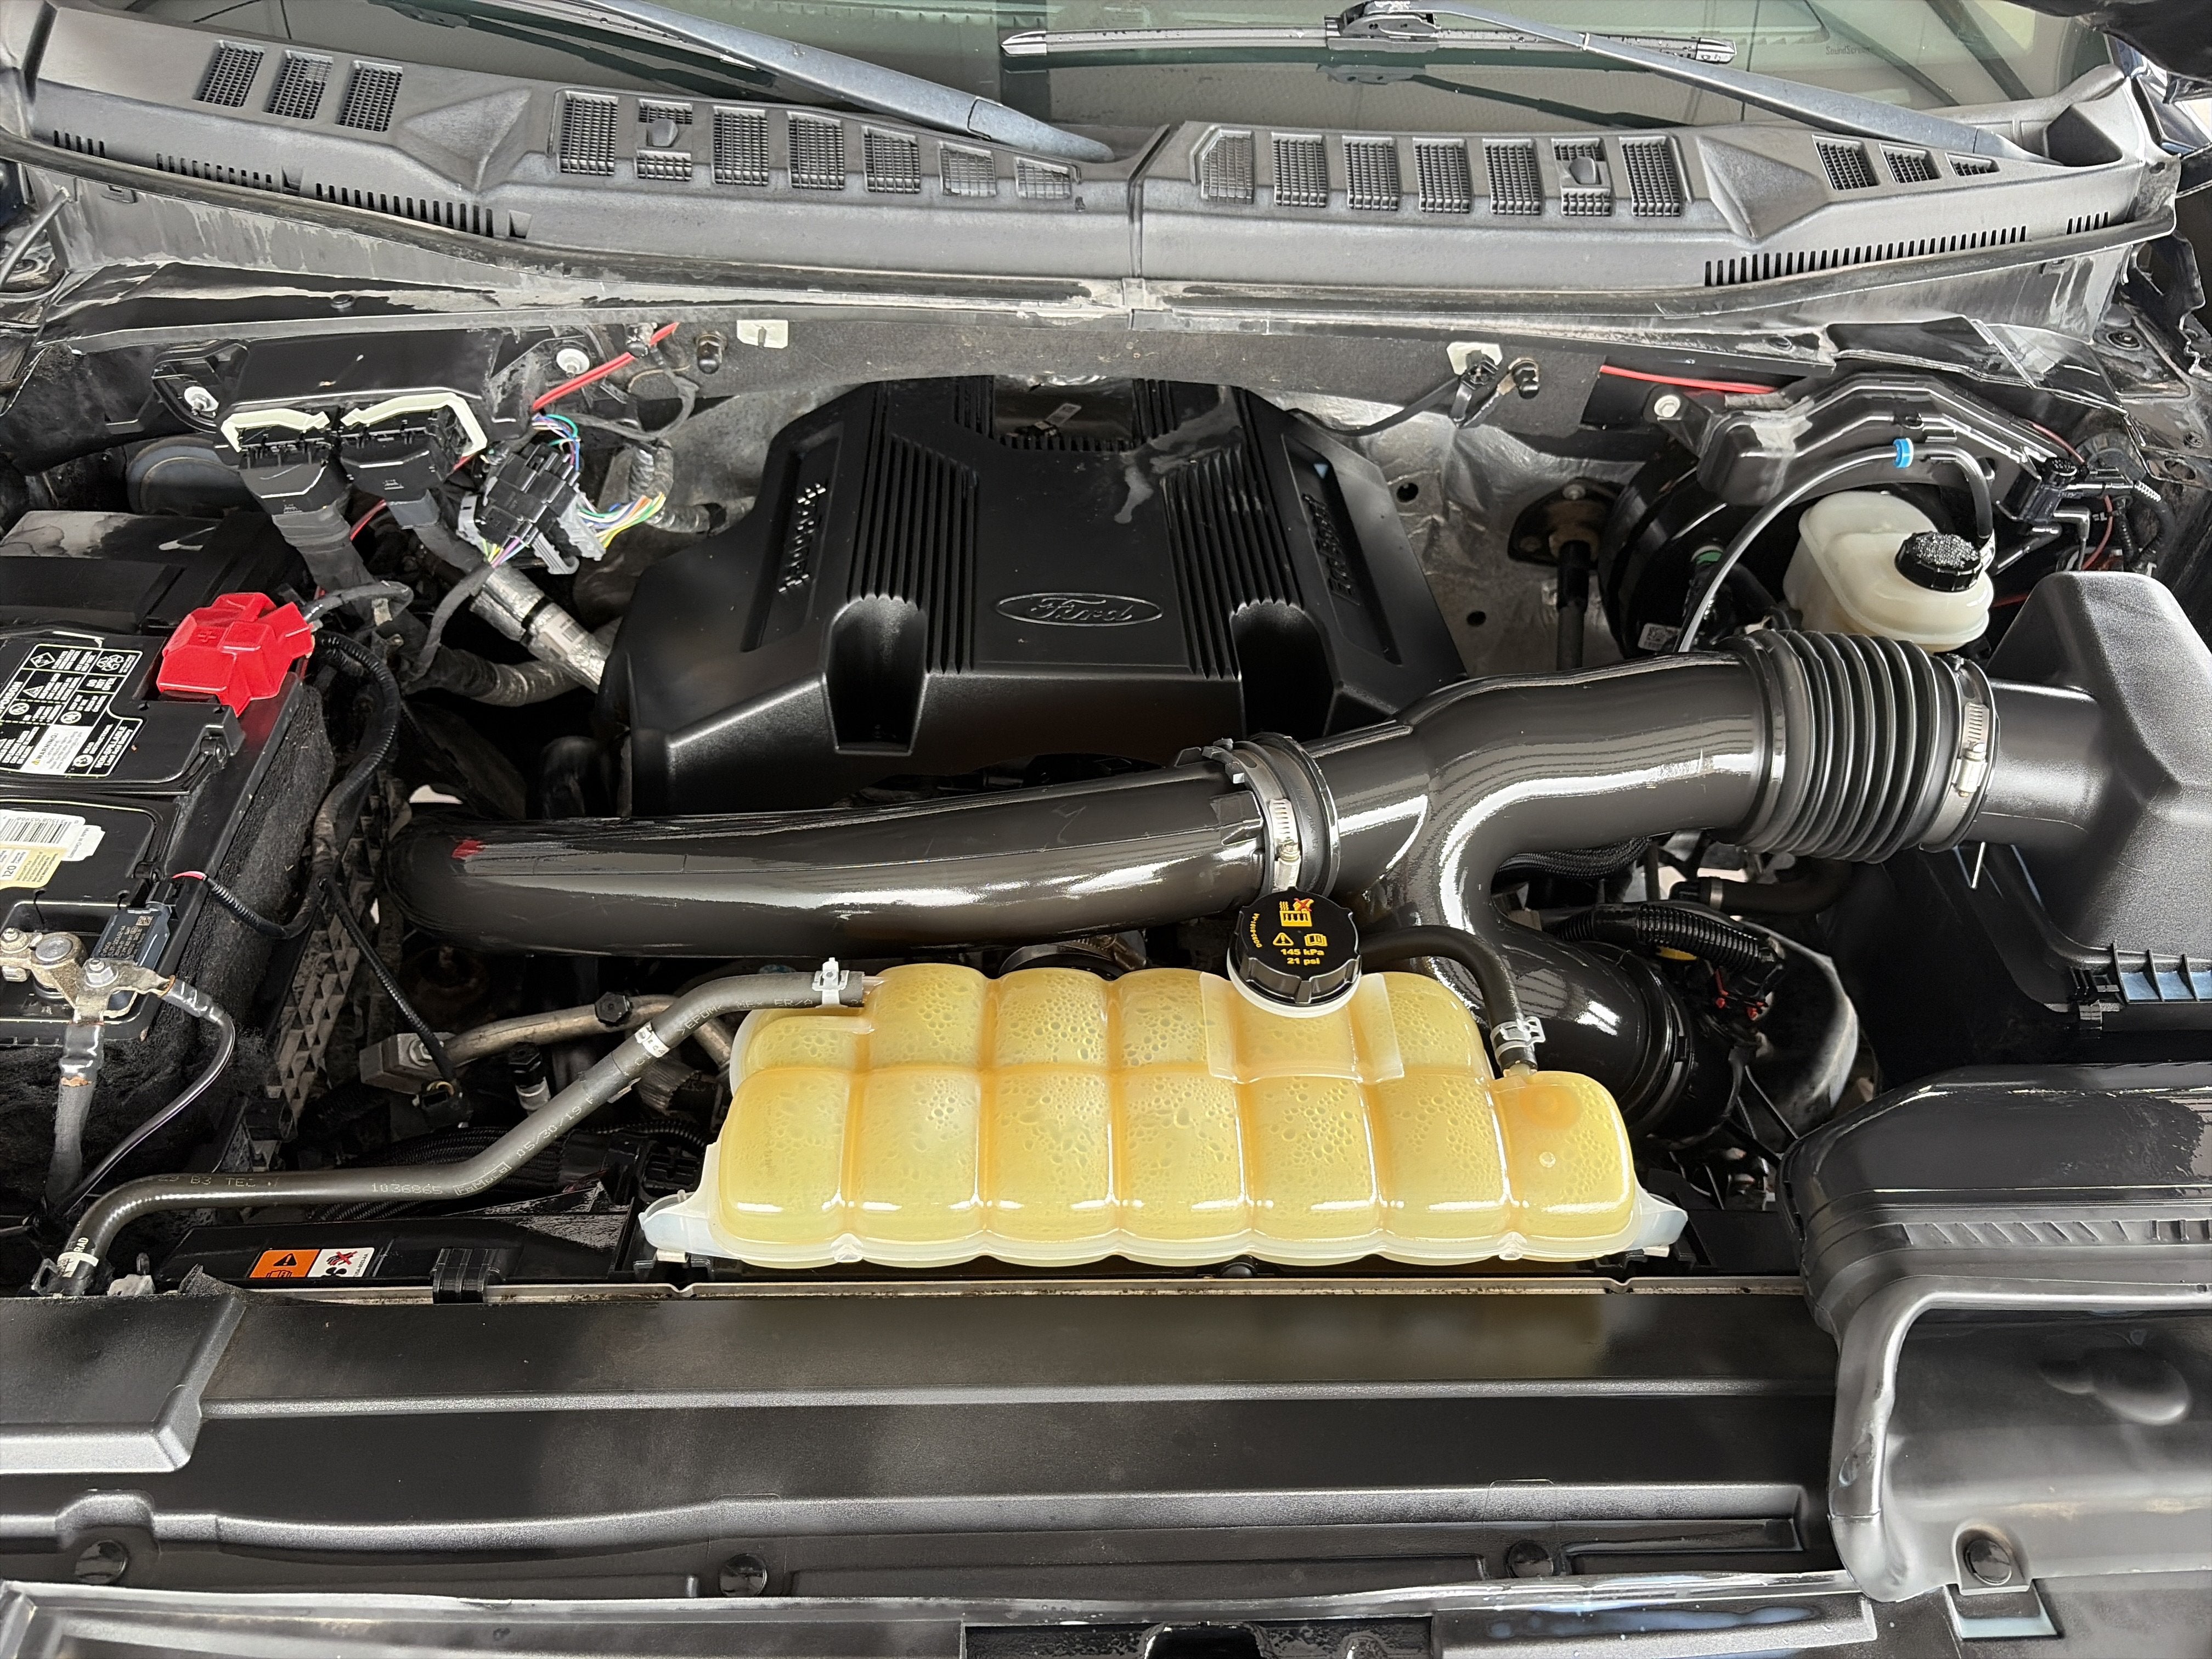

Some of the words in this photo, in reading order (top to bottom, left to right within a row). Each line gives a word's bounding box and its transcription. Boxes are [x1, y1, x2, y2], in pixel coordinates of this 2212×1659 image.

[1030, 597, 1133, 621] Ford
[35, 733, 59, 759] WARNING:
[94, 726, 128, 768] NON-SPILLABLE
[1, 865, 16, 877] 120
[1303, 957, 1321, 966] psi
[516, 1105, 583, 1158] 05/30/19
